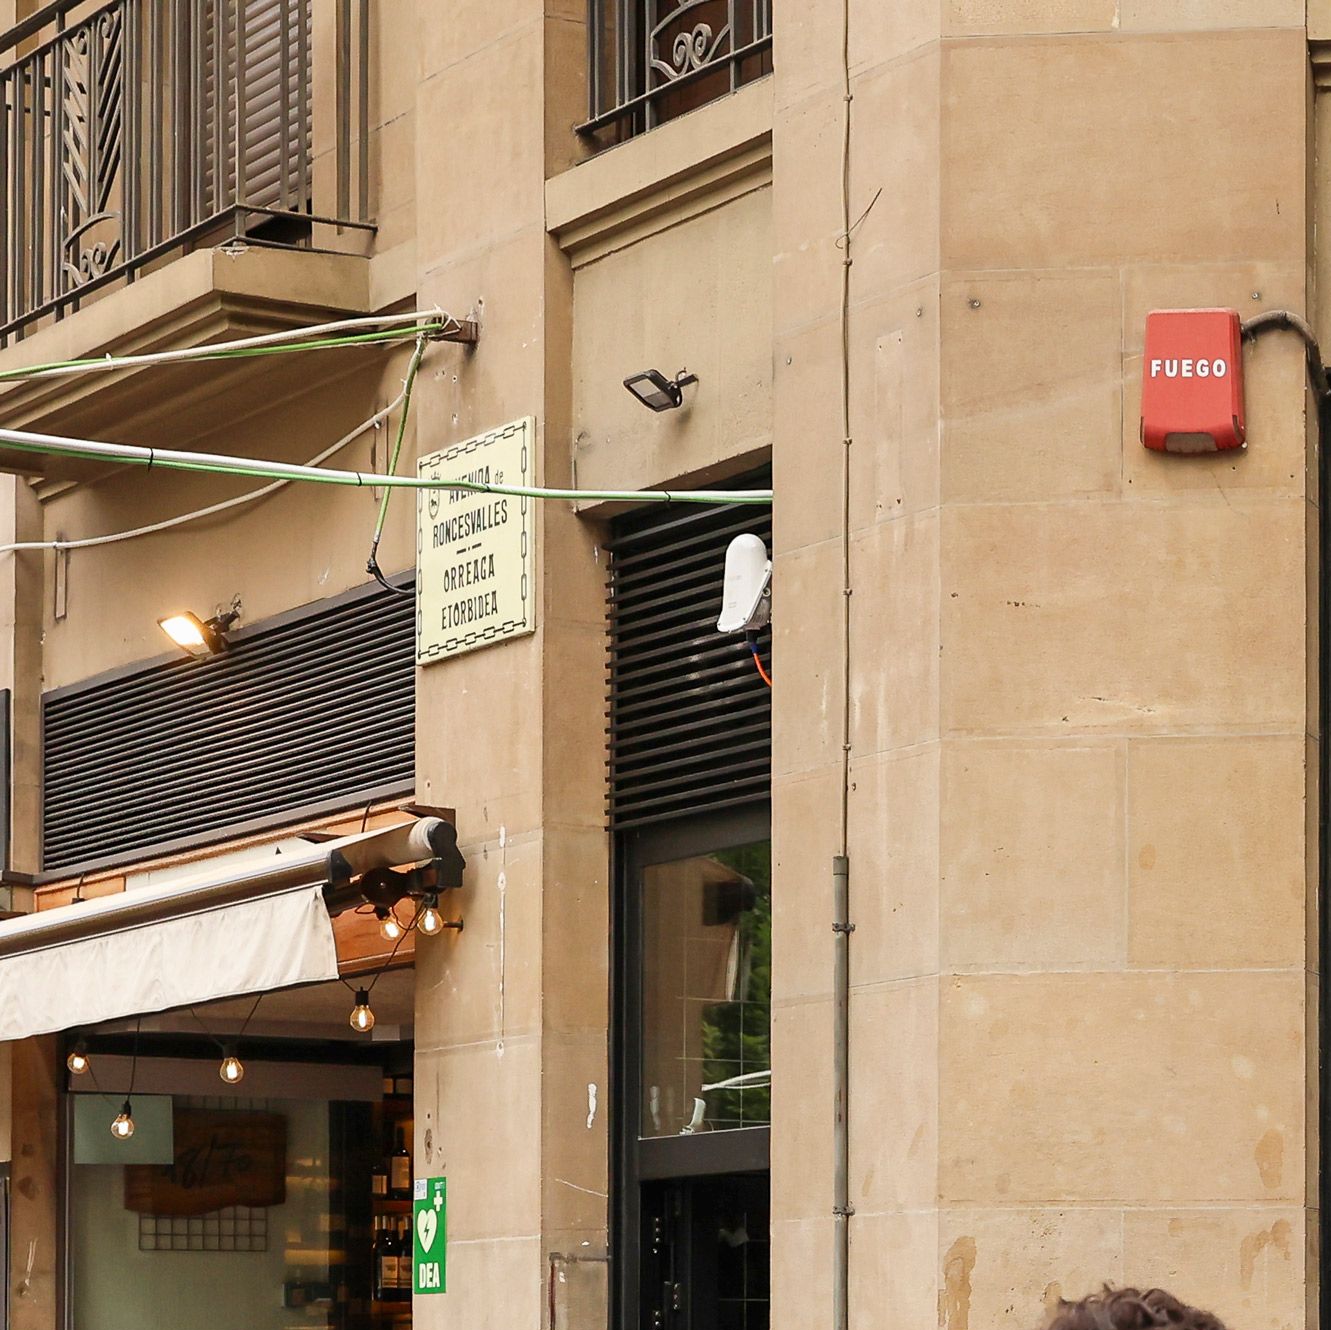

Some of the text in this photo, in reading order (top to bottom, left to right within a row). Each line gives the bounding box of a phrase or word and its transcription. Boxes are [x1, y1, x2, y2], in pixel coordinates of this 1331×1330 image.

[1151, 359, 1226, 377] FUEGO
[449, 465, 490, 504] AVENIDA
[432, 499, 508, 549] RONCESVALLES
[443, 553, 496, 593] ORREAGA
[441, 590, 499, 630] ETORBIDEA
[418, 1262, 441, 1289] DEA
